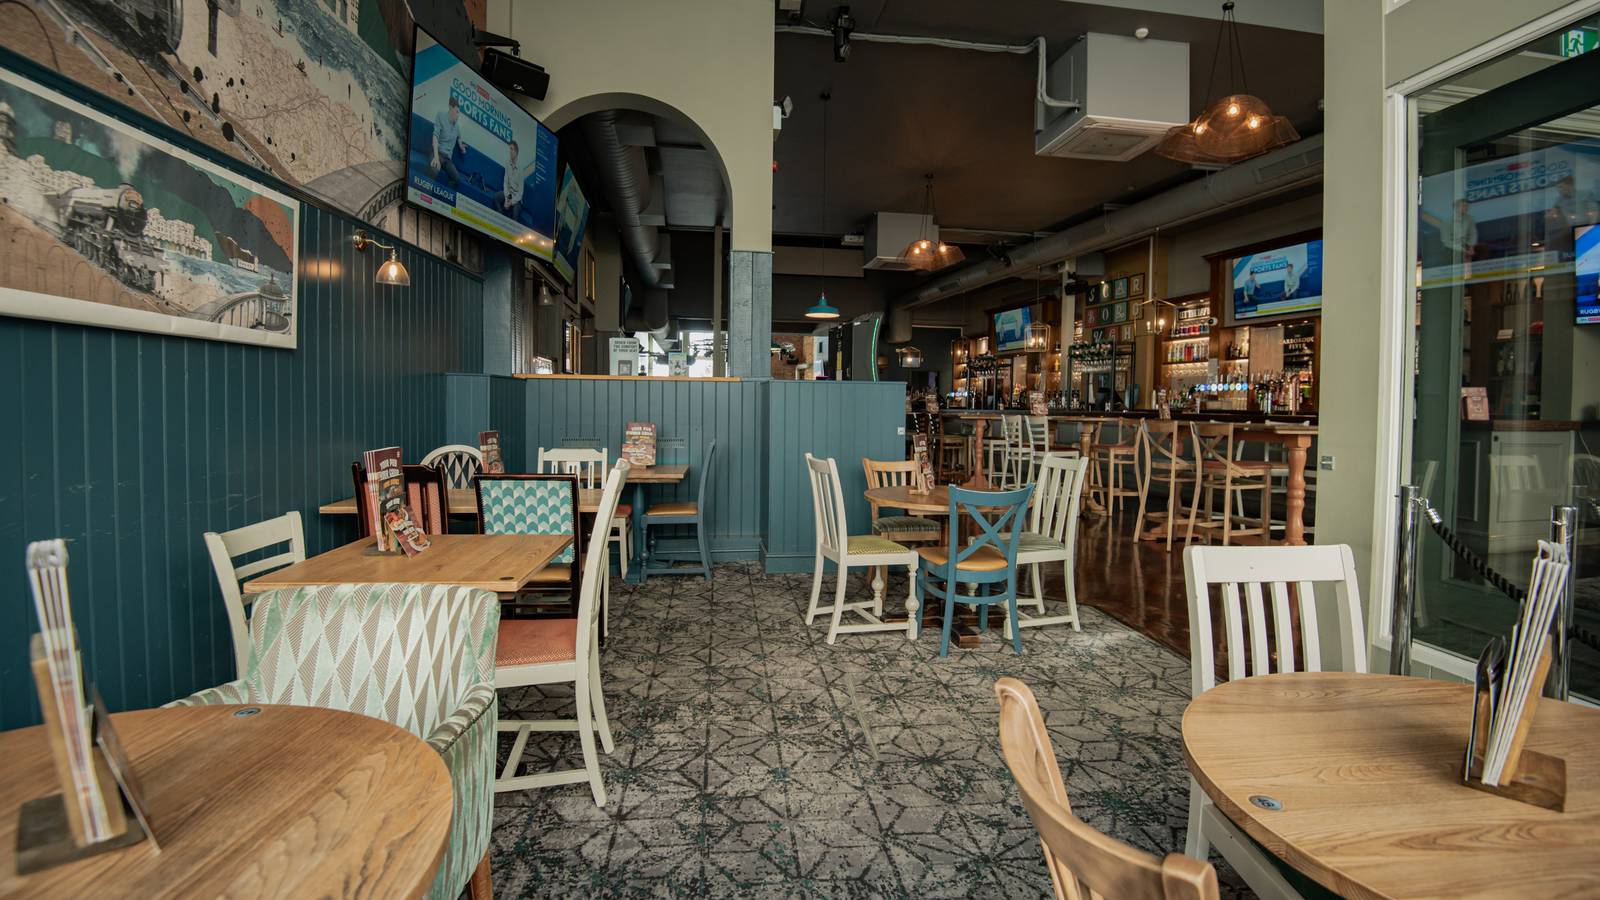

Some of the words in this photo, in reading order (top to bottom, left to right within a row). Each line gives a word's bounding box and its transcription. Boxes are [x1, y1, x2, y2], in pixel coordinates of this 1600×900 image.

[452, 90, 488, 128] SPORTS
[489, 119, 512, 144] FANS
[453, 77, 477, 102] GOOD
[478, 99, 512, 128] MORNING
[414, 176, 434, 191] RUGBY
[433, 184, 455, 202] LEAGUE
